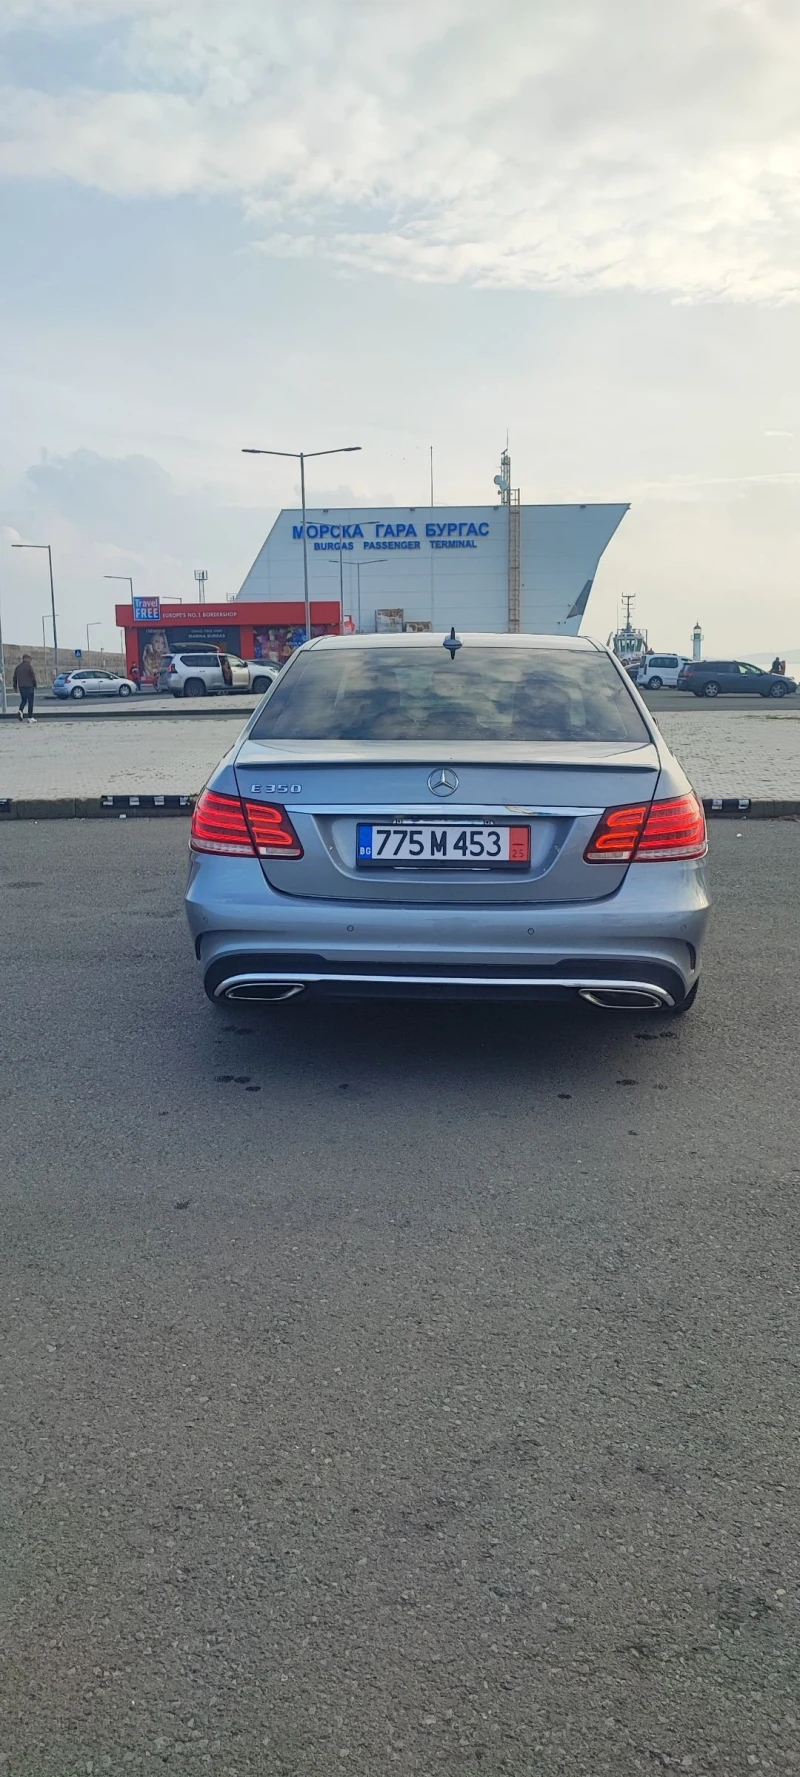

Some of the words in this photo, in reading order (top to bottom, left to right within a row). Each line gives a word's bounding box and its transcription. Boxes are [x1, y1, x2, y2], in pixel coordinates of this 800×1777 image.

[292, 524, 364, 539] МОРСКА
[375, 523, 417, 537] ГАРА
[425, 522, 490, 537] БУРГАС
[313, 541, 354, 551] BURGAS
[363, 541, 421, 550] PASSENGER
[429, 540, 478, 549] TERMINAL
[135, 599, 158, 607] Travel
[135, 608, 159, 619] FREE
[251, 784, 261, 793] E
[265, 784, 302, 793] 350
[359, 847, 371, 855] BG
[376, 830, 424, 856] 775
[430, 831, 448, 856] M
[453, 831, 501, 857] 453
[512, 849, 524, 858] 25
